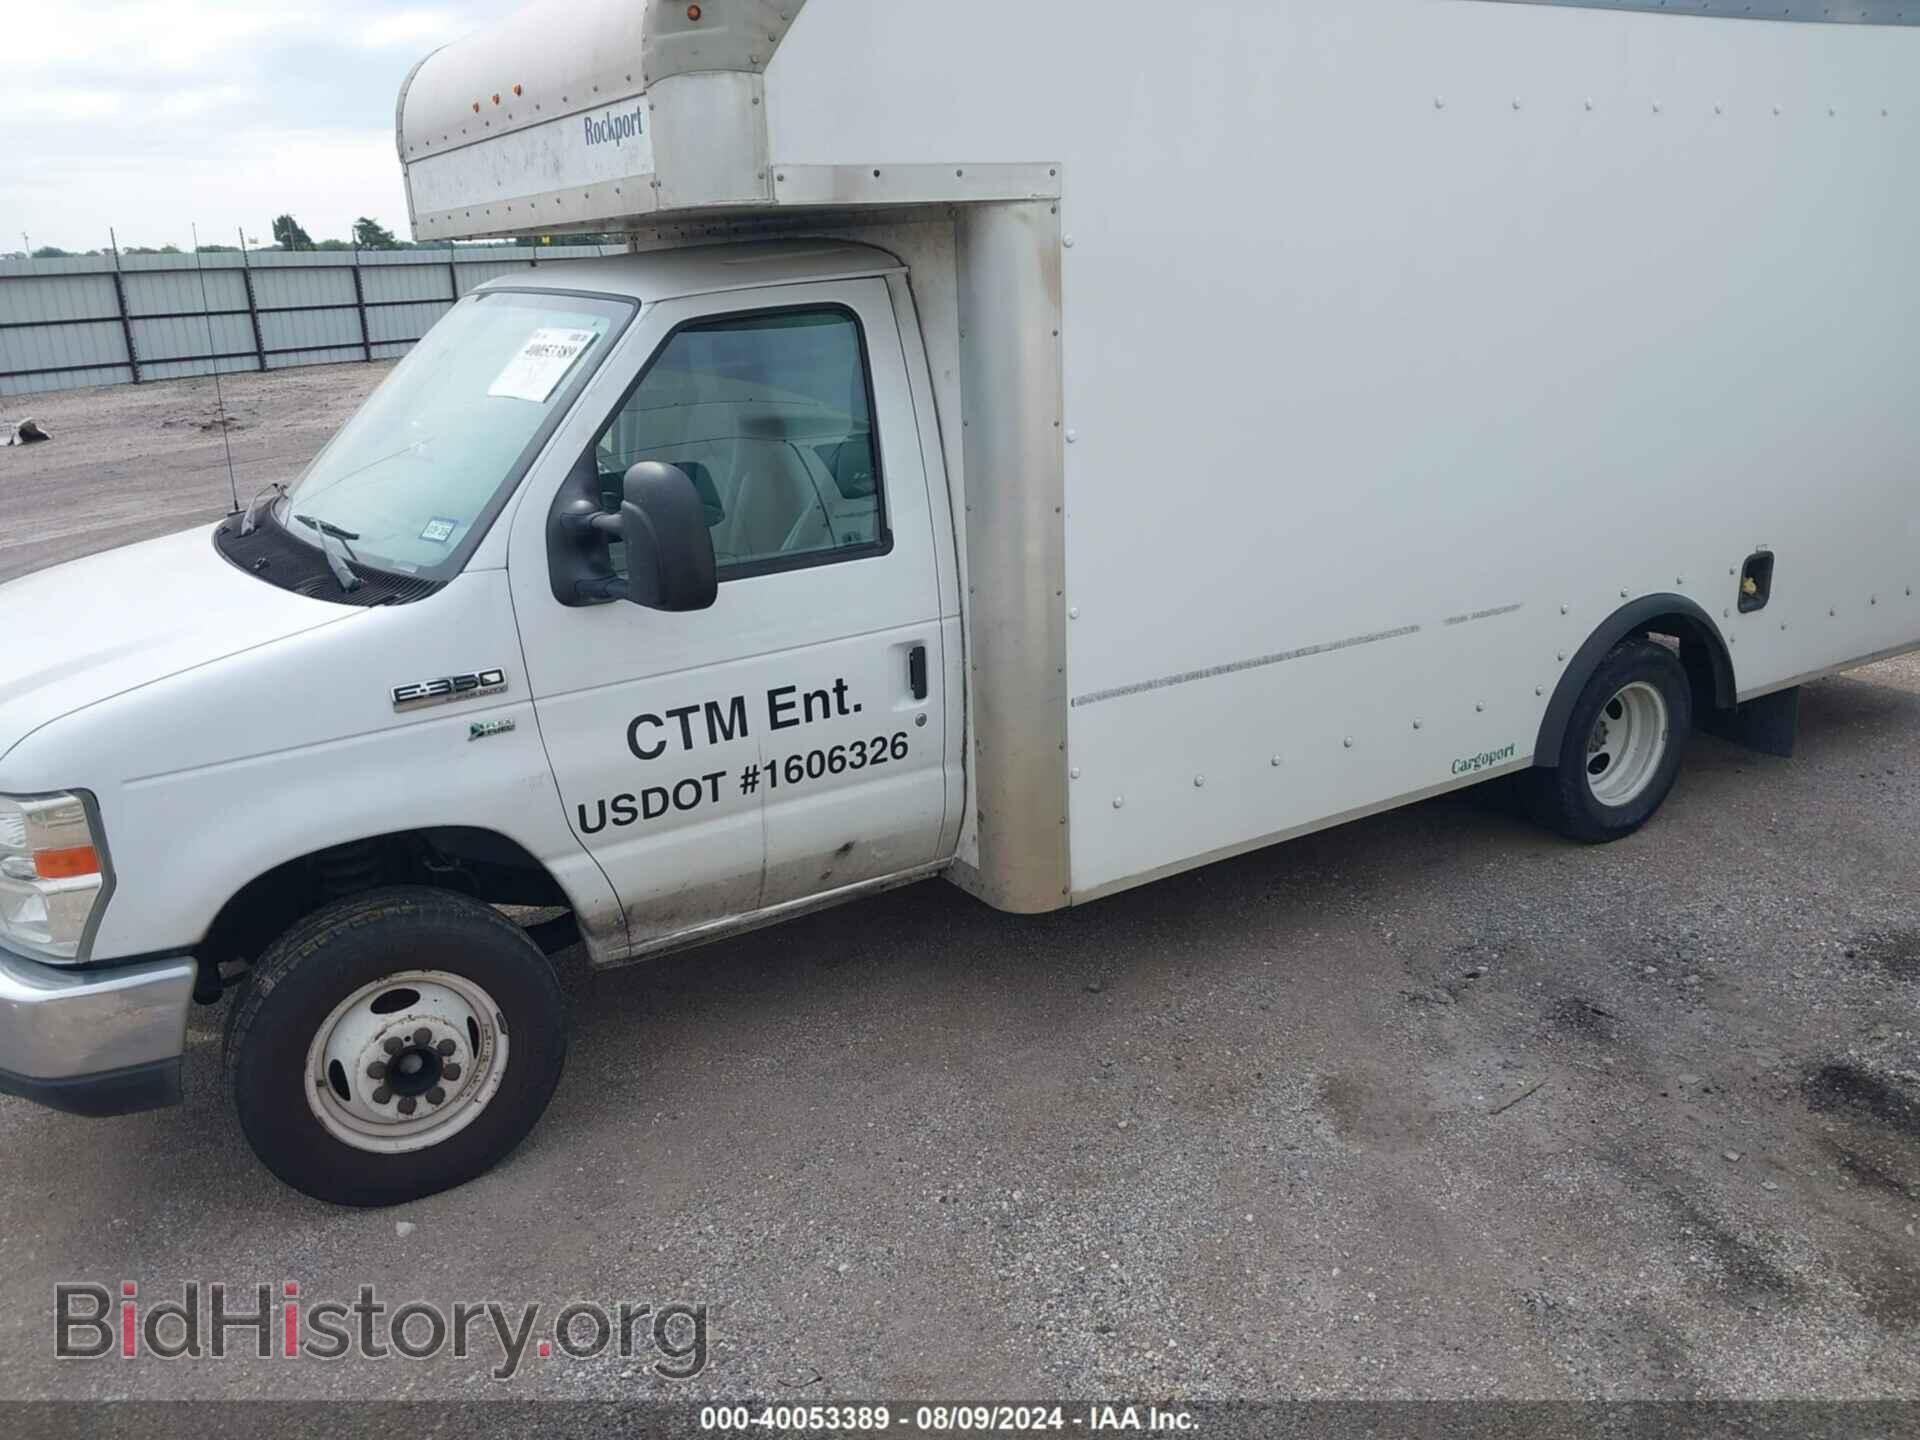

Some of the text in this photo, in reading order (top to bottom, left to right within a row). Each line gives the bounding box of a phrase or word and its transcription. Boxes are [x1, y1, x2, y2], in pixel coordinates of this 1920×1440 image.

[584, 105, 643, 148] Rockport
[626, 678, 863, 761] CTM Ent.
[577, 731, 910, 834] USDOT #1606326
[1451, 742, 1515, 774] Cargoport
